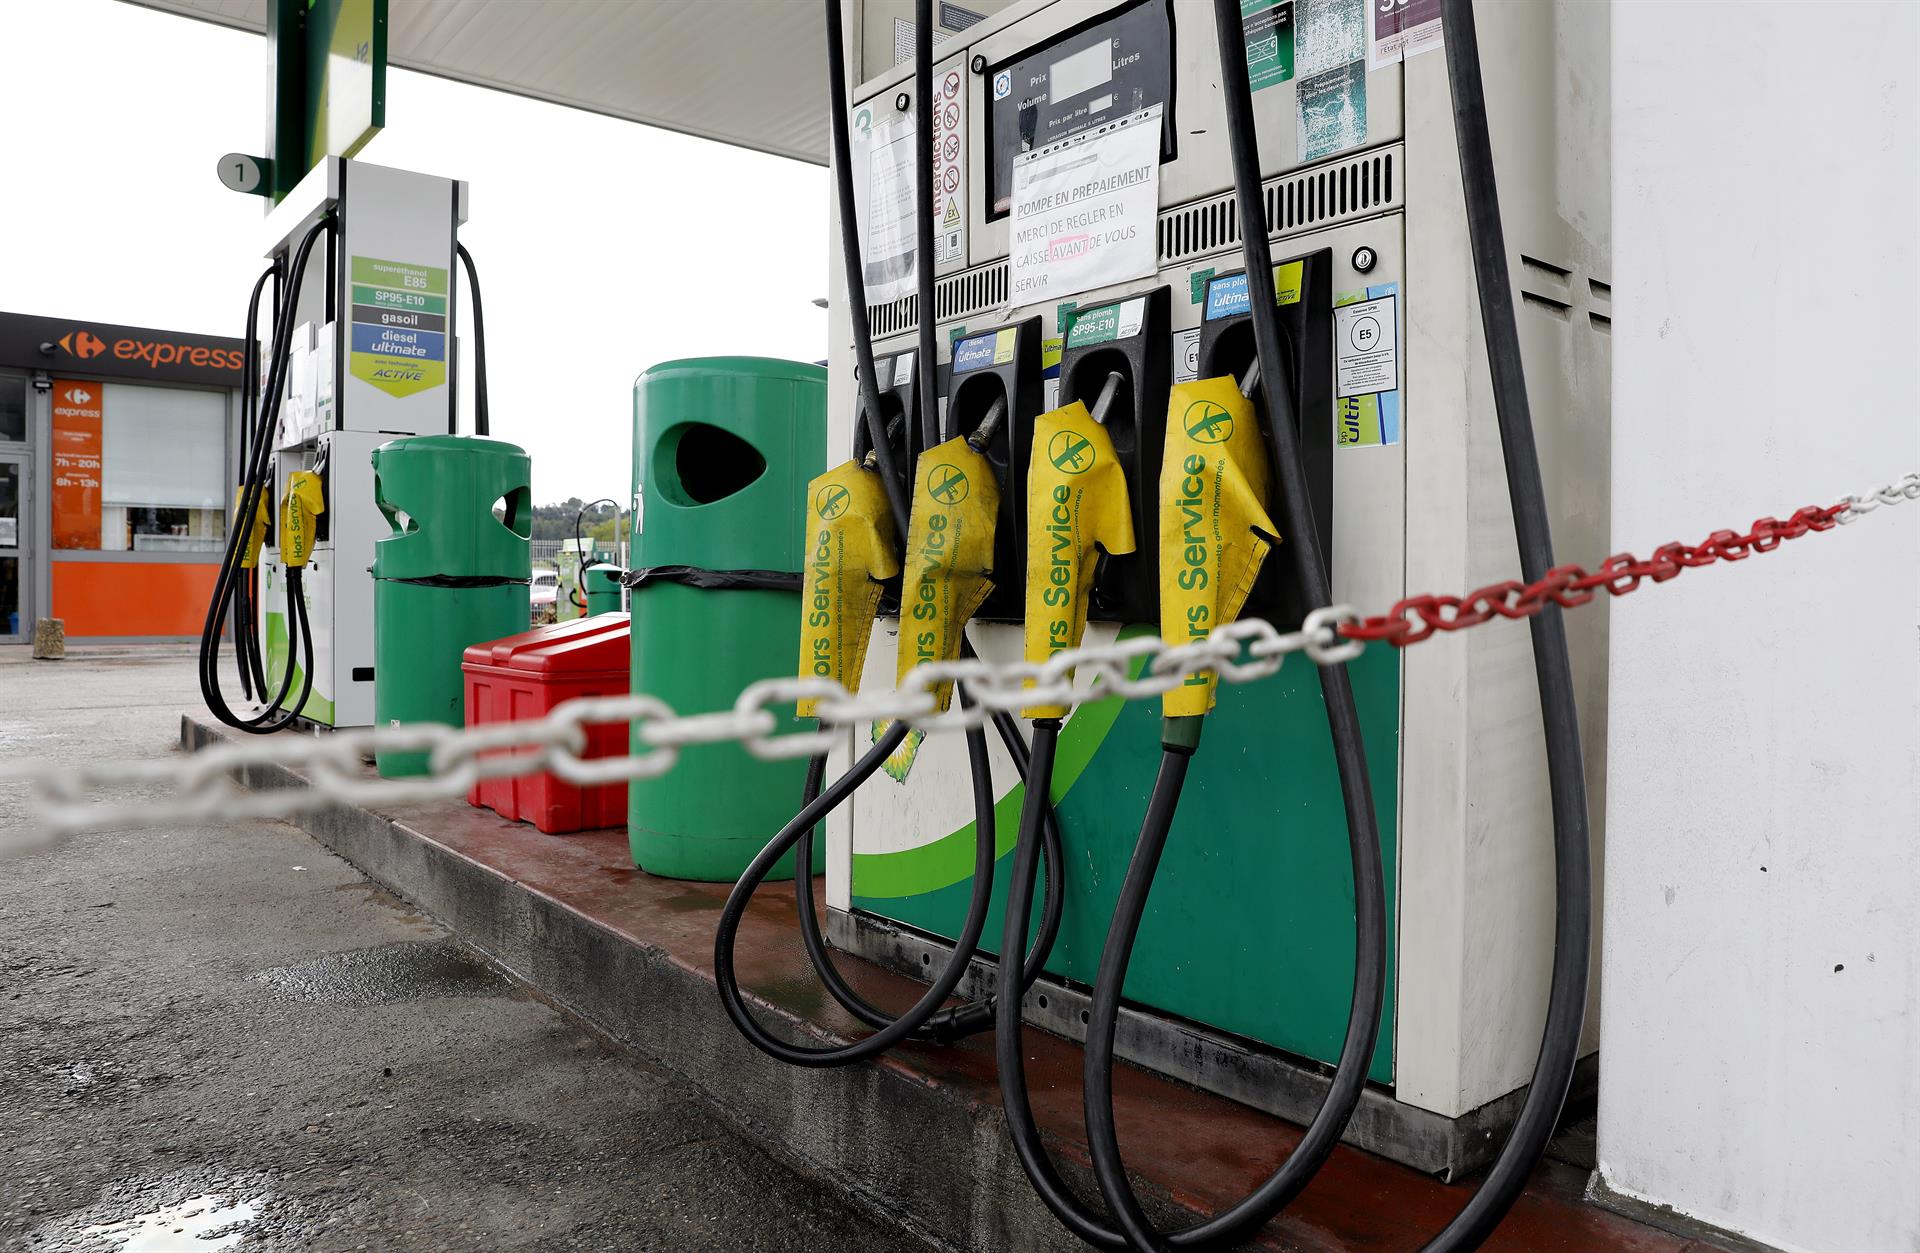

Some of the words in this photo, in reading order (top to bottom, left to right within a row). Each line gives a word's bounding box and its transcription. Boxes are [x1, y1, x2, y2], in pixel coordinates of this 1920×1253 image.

[1278, 10, 1287, 19] pas
[1112, 51, 1140, 71] Litres
[1030, 73, 1047, 87] Prix
[1017, 92, 1047, 112] Volume
[1049, 118, 1061, 128] Prix
[1062, 113, 1073, 123] par
[1074, 108, 1088, 117] litre
[235, 163, 243, 182] 1
[1017, 197, 1052, 217] POMPE
[1055, 190, 1069, 206] EN
[1072, 165, 1151, 201] PREPAIEMENT
[948, 209, 956, 218] EX
[1017, 225, 1048, 245] MERCI
[1050, 219, 1063, 235] DE
[1066, 207, 1107, 230] REGLER
[1109, 202, 1124, 219] EN
[1016, 249, 1050, 269] CAISSE
[1051, 239, 1088, 260] AVANT
[1089, 234, 1101, 250] DE
[1105, 225, 1136, 244] VOUS
[403, 275, 427, 289] E85
[1015, 274, 1048, 293] SERVIR
[1212, 279, 1230, 291] sans
[1231, 277, 1248, 289] plo
[375, 290, 425, 306] SP95-E10
[1214, 292, 1250, 307] ultima
[381, 313, 418, 326] gasoil
[1076, 313, 1092, 323] sans
[1092, 308, 1113, 320] plomb
[1072, 318, 1115, 337] SP95-E10
[1359, 328, 1372, 341] E5
[381, 330, 417, 344] diesel
[968, 337, 985, 347] diesel
[113, 339, 244, 369] express
[371, 343, 427, 357] ultimate
[958, 347, 992, 363] ultimate
[1044, 344, 1062, 353] ultima
[1189, 353, 1199, 363] E1
[374, 369, 423, 381] ACTIVE
[54, 408, 100, 418] express
[55, 458, 70, 467] 7h
[78, 459, 100, 469] 20h
[55, 477, 71, 487] 8h
[79, 479, 99, 488] 13h
[1212, 457, 1226, 517] momentanée.
[290, 493, 301, 531] Service
[1176, 453, 1209, 591] Service
[1213, 518, 1222, 542] gêne
[293, 534, 303, 559] Hors
[1044, 484, 1071, 607] Service
[913, 513, 948, 621] Service
[809, 529, 831, 628] Service
[814, 637, 831, 678] ors
[917, 632, 935, 666] ors
